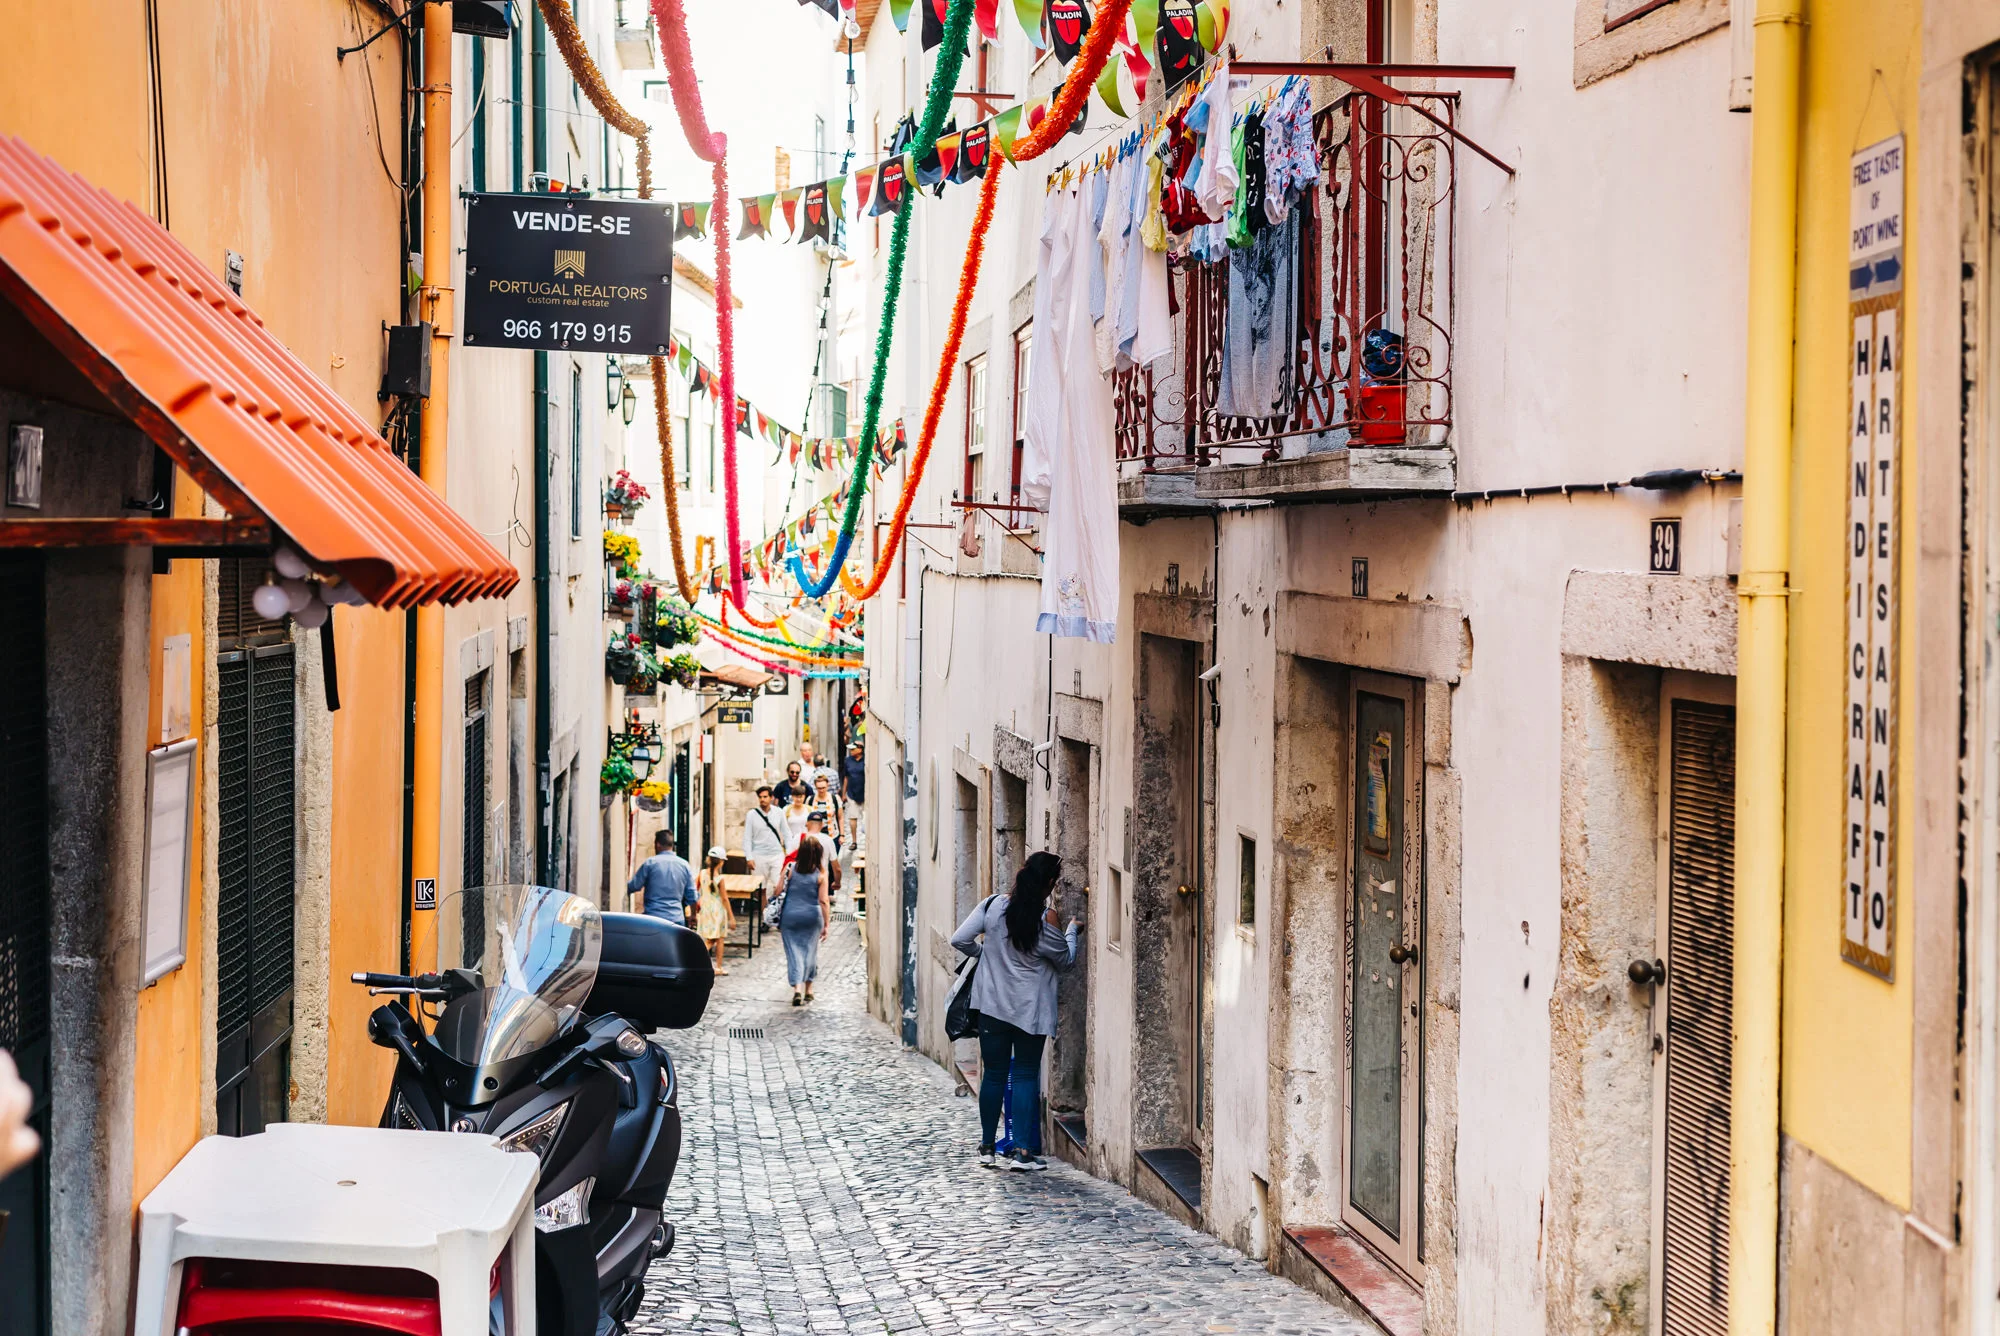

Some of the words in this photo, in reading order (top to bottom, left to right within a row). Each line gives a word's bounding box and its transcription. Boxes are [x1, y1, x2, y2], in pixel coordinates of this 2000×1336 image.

[1052, 10, 1083, 20] PALADIN
[1166, 9, 1194, 18] PALADIN
[966, 136, 988, 148] PALADIN
[1853, 160, 1873, 188] FREE
[1874, 147, 1900, 178] TASTE
[1871, 190, 1881, 211] OF
[512, 210, 631, 236] VENDE-SE
[1852, 223, 1874, 251] PORT
[1876, 214, 1900, 243] WINE
[489, 279, 570, 297] PORTUGAL
[574, 284, 648, 300] REALTORS
[526, 296, 561, 305] custom
[562, 297, 580, 306] real
[582, 299, 610, 308] estate
[503, 319, 542, 339] 966
[549, 322, 587, 341] 179
[593, 324, 632, 344] 915
[1654, 524, 1675, 569] 39
[1354, 562, 1365, 595] 37
[1850, 338, 1870, 920] HANDICRAFT
[1871, 334, 1893, 930] ARTESANATO
